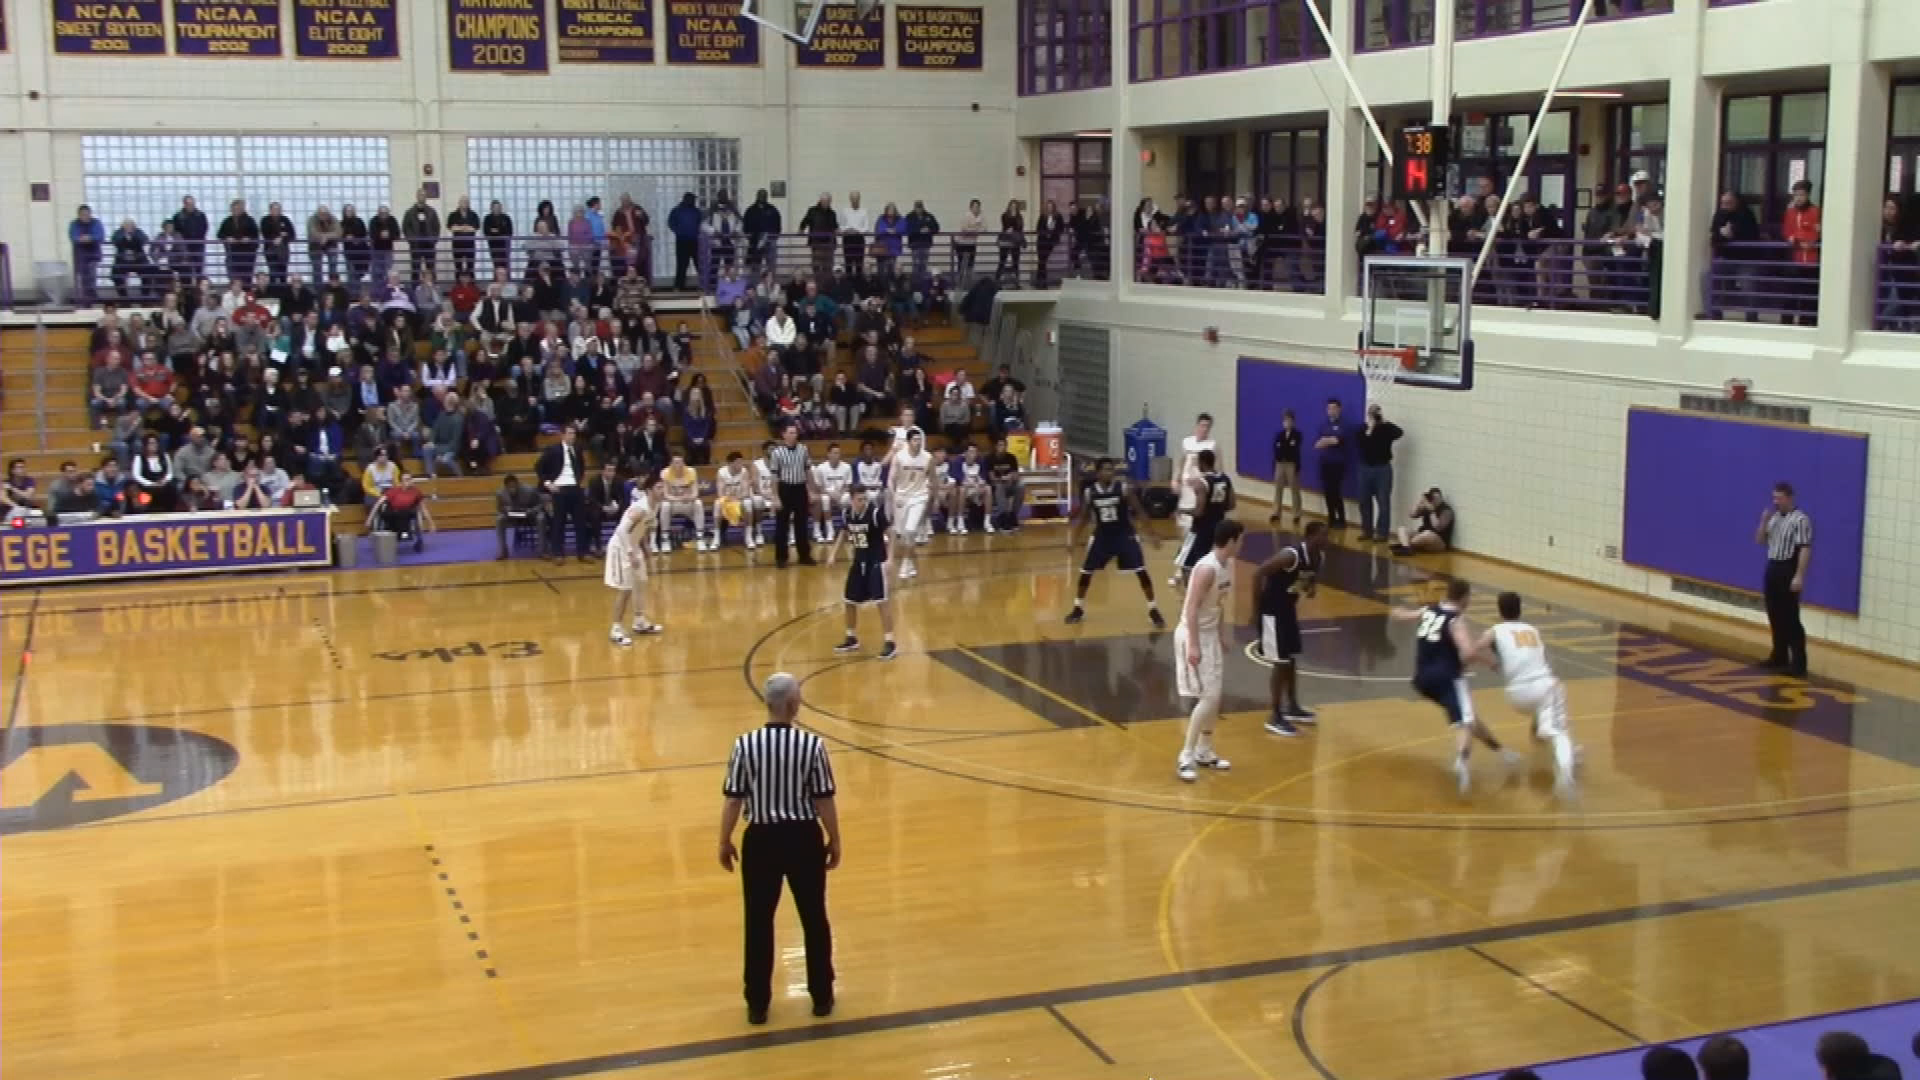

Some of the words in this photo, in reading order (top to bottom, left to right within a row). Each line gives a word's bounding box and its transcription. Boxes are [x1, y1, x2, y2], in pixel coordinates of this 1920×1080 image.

[75, 5, 141, 19] NCAA
[196, 8, 258, 22] NCAA
[315, 10, 376, 24] NCAA
[56, 21, 101, 35] SWEET
[105, 22, 163, 36] SIXTEEN
[178, 24, 277, 38] TOURNAMENT
[455, 13, 540, 39] CHAMPIONS
[567, 26, 645, 37] CHAMPIONS
[686, 19, 737, 31] NCAA
[816, 23, 865, 36] NCAA
[906, 26, 973, 38] NESCAC
[308, 26, 345, 40] ELITE
[348, 27, 384, 41] EIGHT
[905, 40, 975, 53] CHAMPIONS
[472, 44, 525, 64] 2003
[0, 532, 73, 571] EGE
[97, 519, 316, 566] BASKETBALL
